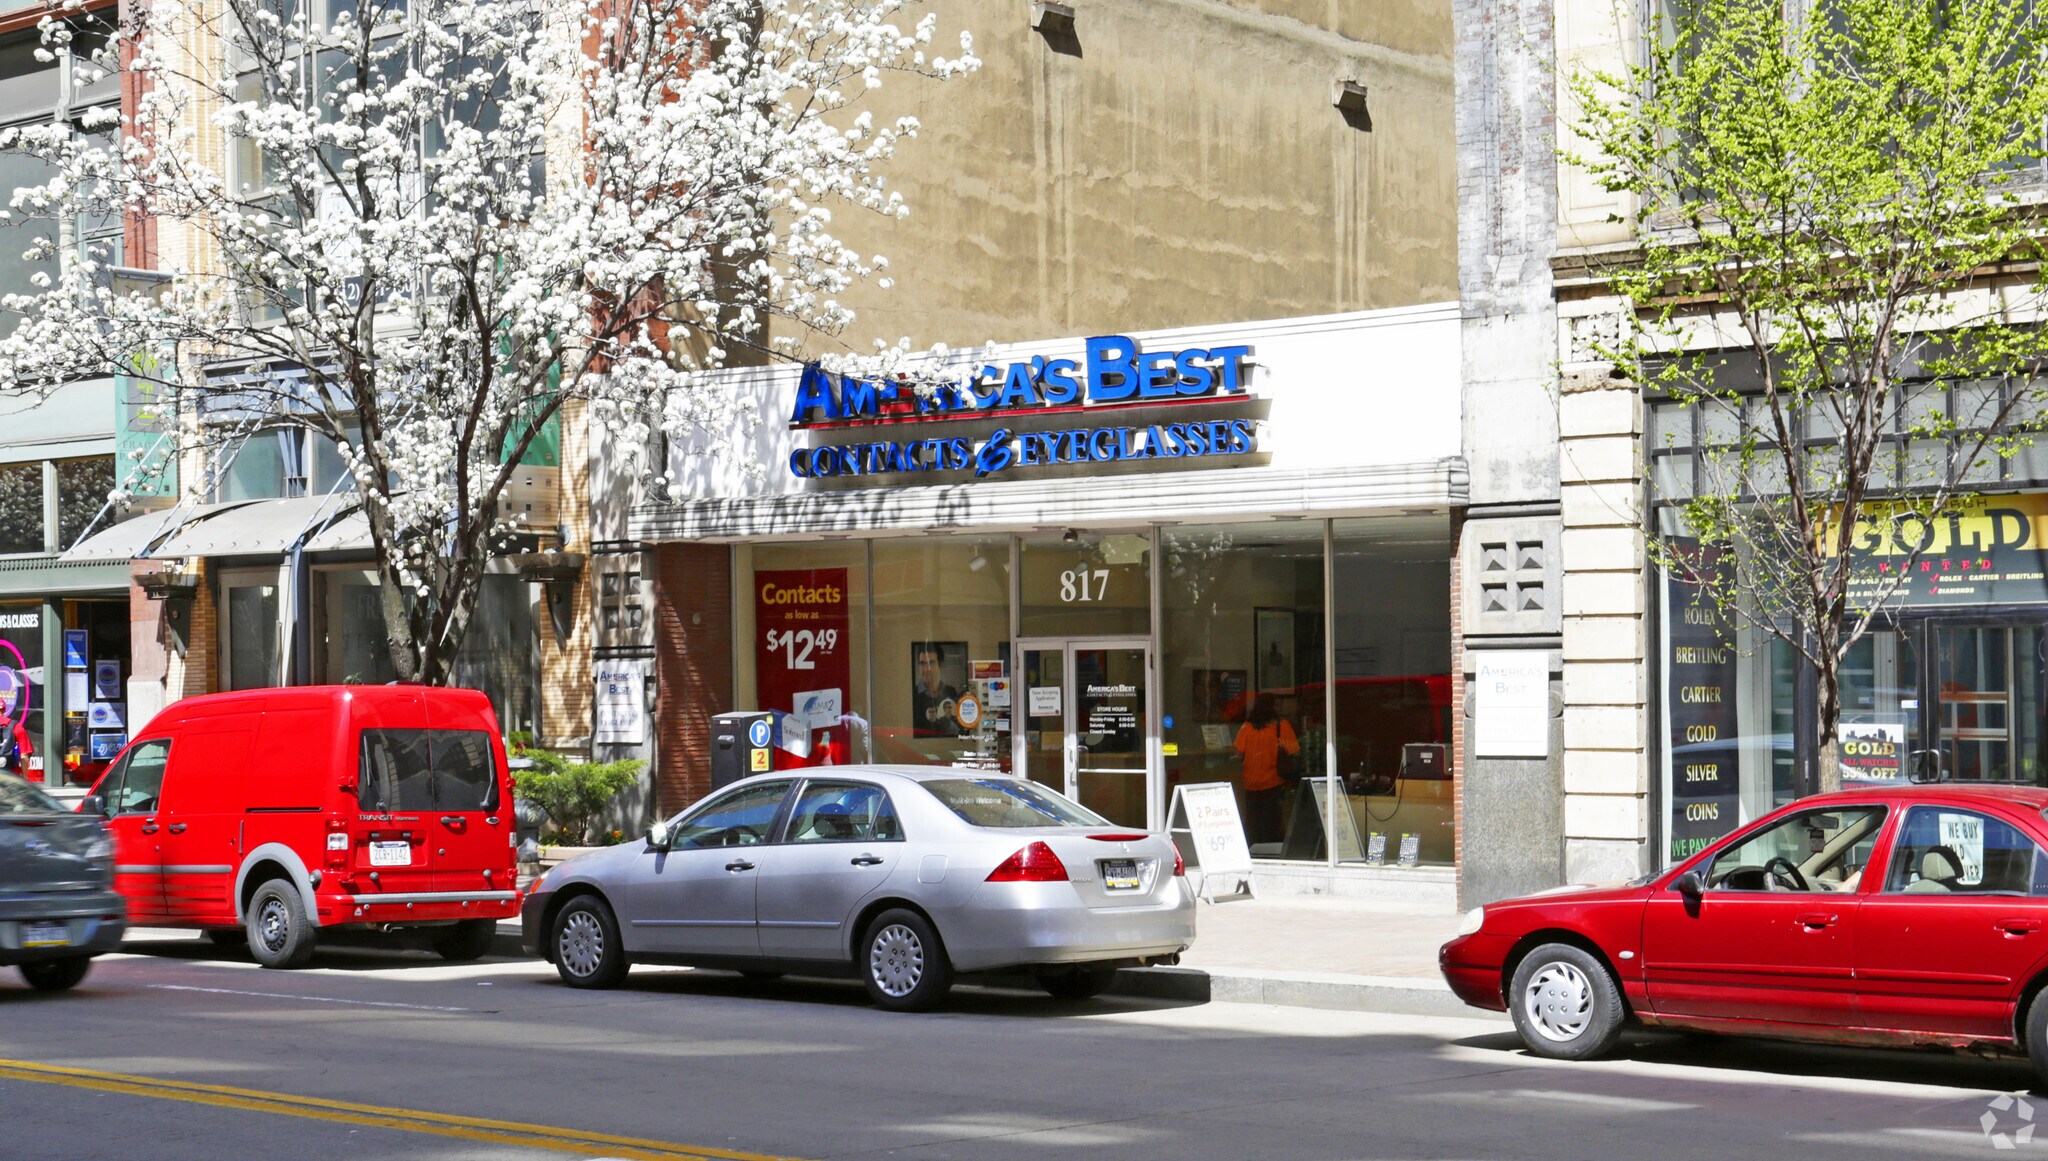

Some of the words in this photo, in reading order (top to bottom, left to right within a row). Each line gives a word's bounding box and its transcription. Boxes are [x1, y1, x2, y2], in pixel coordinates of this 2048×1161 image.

[1085, 336, 1250, 401] BEST
[789, 437, 969, 478] CONTACTS
[974, 429, 1015, 478] &
[1019, 418, 1253, 464] EYEGLASSES
[1850, 508, 2031, 555] GOLD
[761, 582, 840, 605] Contacts
[1060, 569, 1109, 602] 817
[12, 614, 39, 628] CLASSES
[784, 611, 793, 620] as
[795, 609, 809, 619] low
[811, 611, 819, 620] as
[1684, 608, 1716, 625] ROLEX
[1676, 647, 1727, 665] BREITLING
[609, 684, 630, 694] BEST
[1087, 684, 1119, 692] AMERICA'S
[1119, 684, 1136, 692] BEST
[1495, 682, 1527, 694] BEST
[1681, 686, 1721, 703] CARTIER
[756, 725, 766, 743] P
[1686, 725, 1717, 742] GOLD
[1844, 741, 1895, 755] GOLD
[756, 751, 765, 765] 2
[1860, 758, 1899, 766] WATCHES
[1686, 764, 1718, 782] SILVER
[1870, 767, 1899, 780] OFF
[1196, 807, 1203, 818] 2
[1204, 806, 1230, 818] Pairs
[1686, 803, 1718, 821] COINS
[1948, 822, 1960, 839] WE
[1962, 822, 1978, 839] BUY
[1672, 839, 1687, 857] WE
